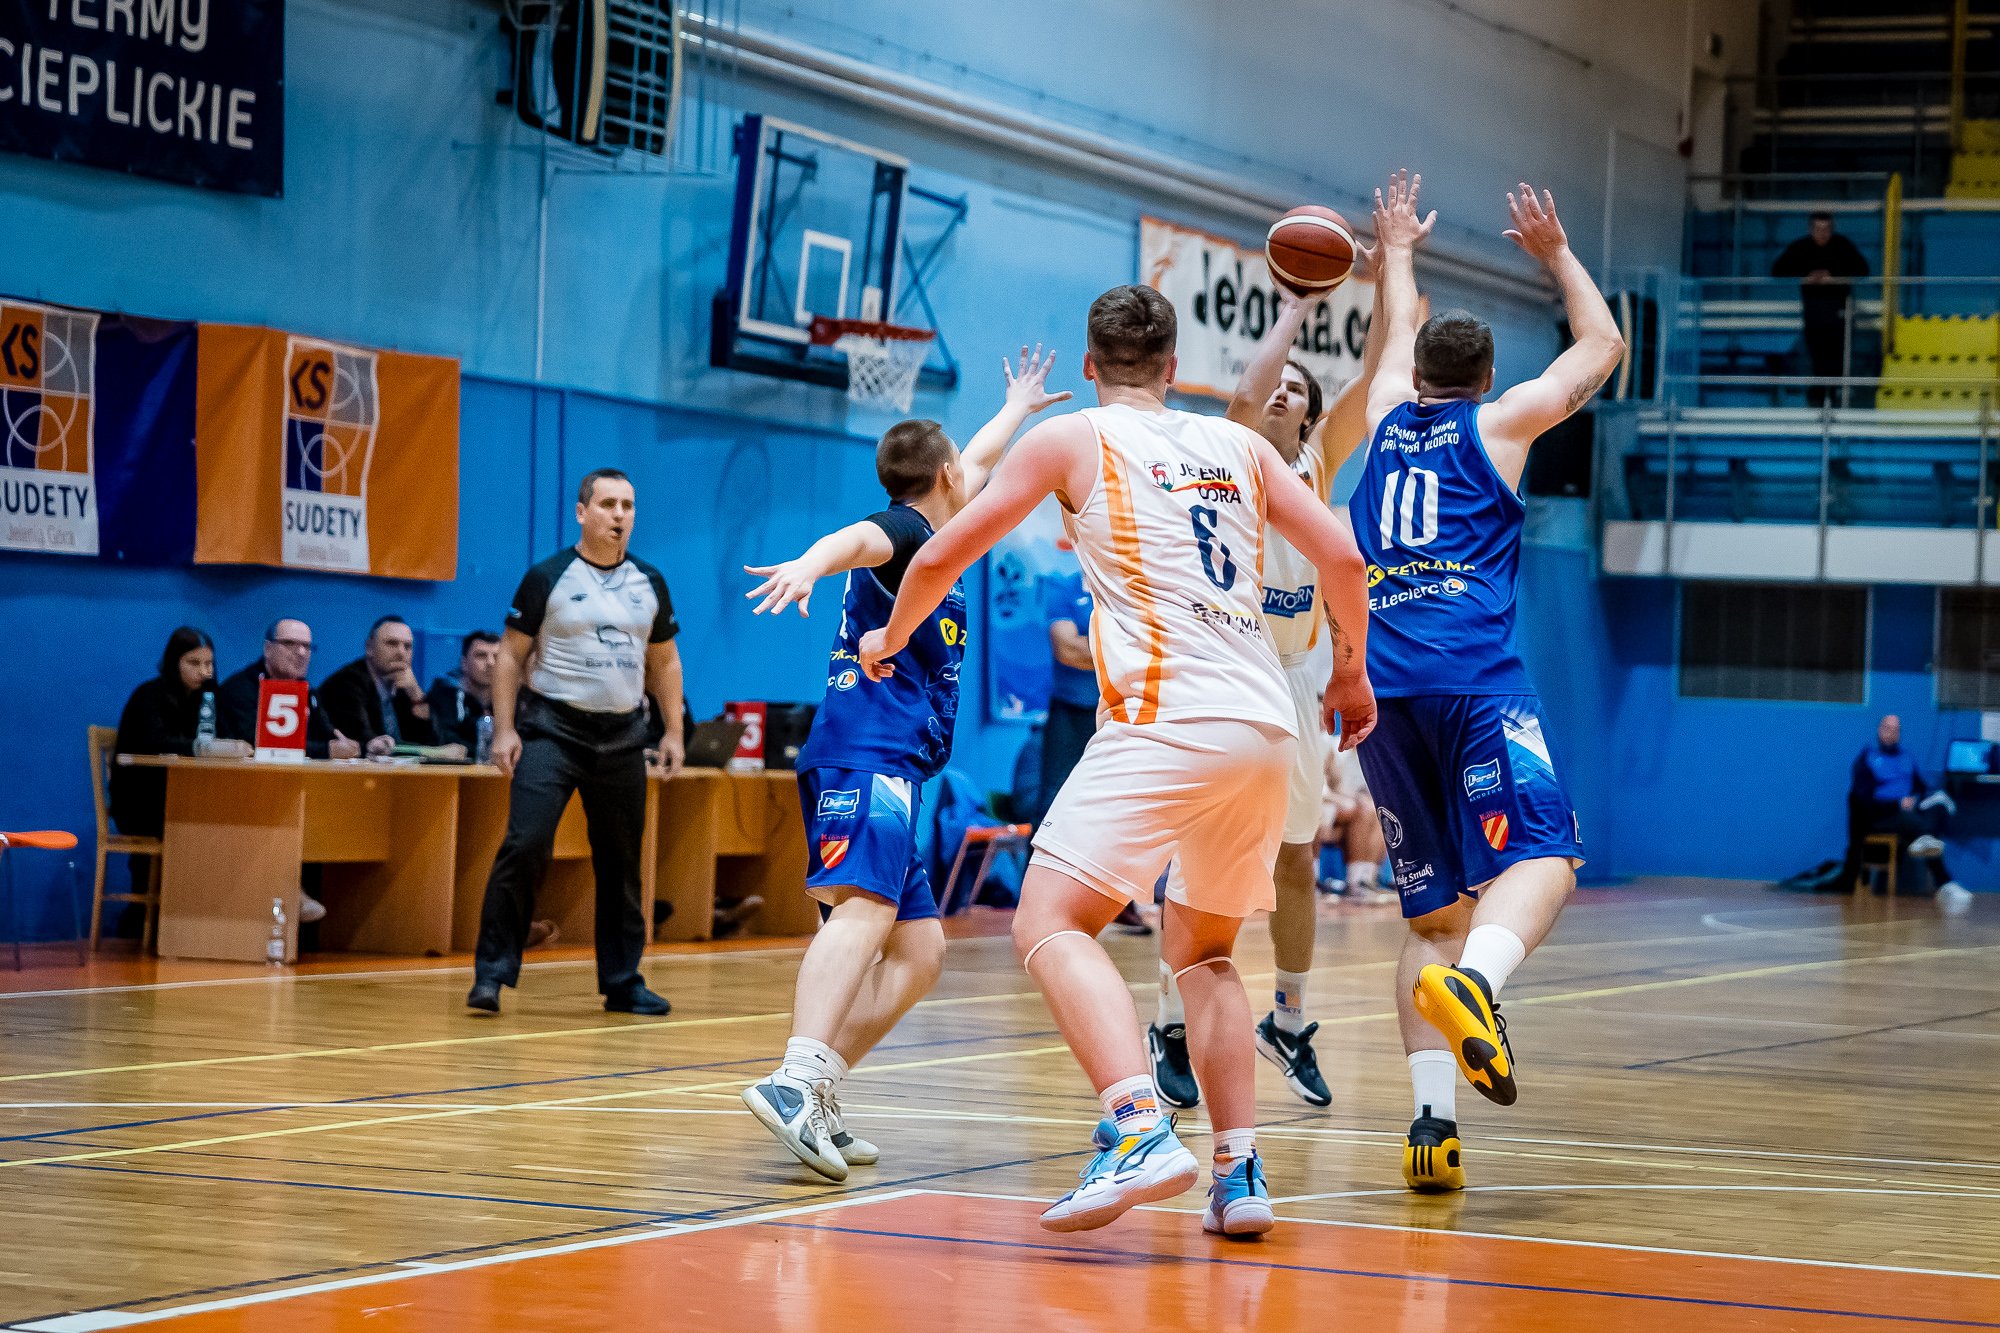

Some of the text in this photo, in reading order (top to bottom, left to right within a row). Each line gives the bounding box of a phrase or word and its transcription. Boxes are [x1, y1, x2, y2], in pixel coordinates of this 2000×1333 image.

[0, 480, 88, 518] UDETY
[286, 501, 361, 538] SUDETY
[1380, 467, 1439, 550] 10
[1188, 505, 1237, 592] 6
[1369, 583, 1440, 611] E.Leclerc
[266, 693, 299, 738] 5
